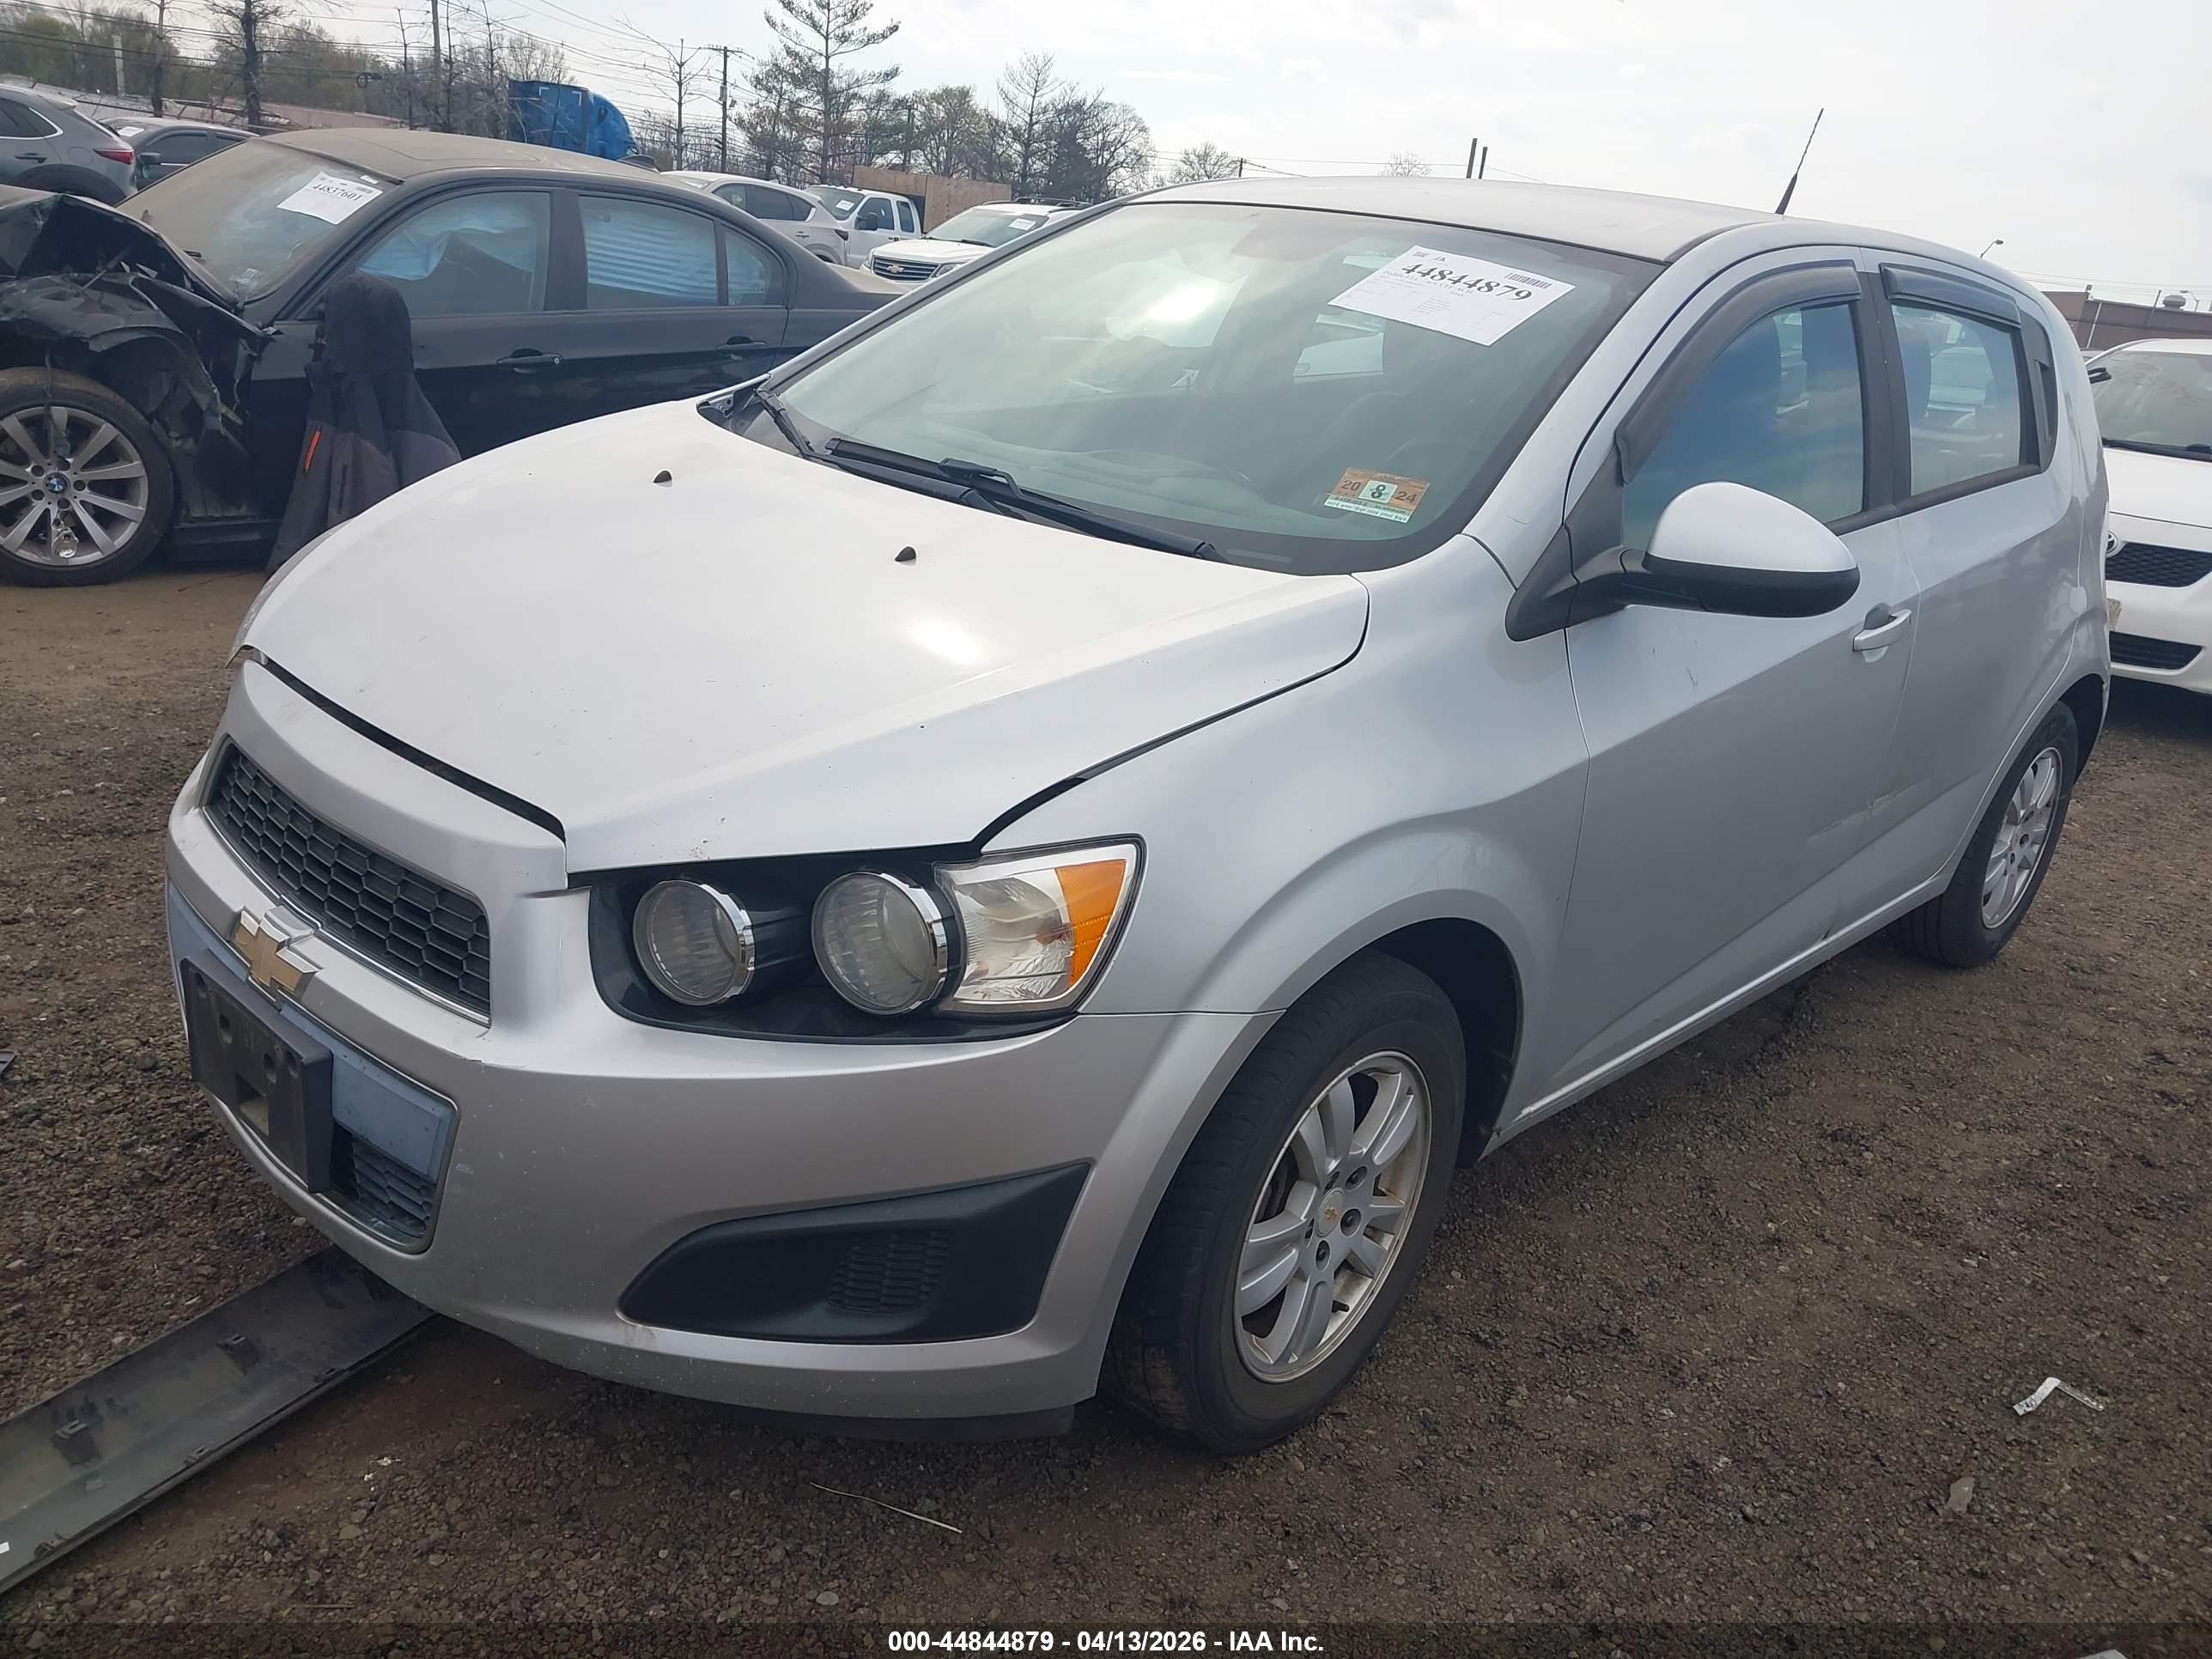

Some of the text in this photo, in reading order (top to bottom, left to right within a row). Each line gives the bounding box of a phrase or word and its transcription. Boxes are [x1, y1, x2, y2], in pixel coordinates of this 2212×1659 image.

[312, 184, 362, 201] 44837601
[1401, 264, 1533, 301] 44844879
[1340, 480, 1417, 503] 20 8 24
